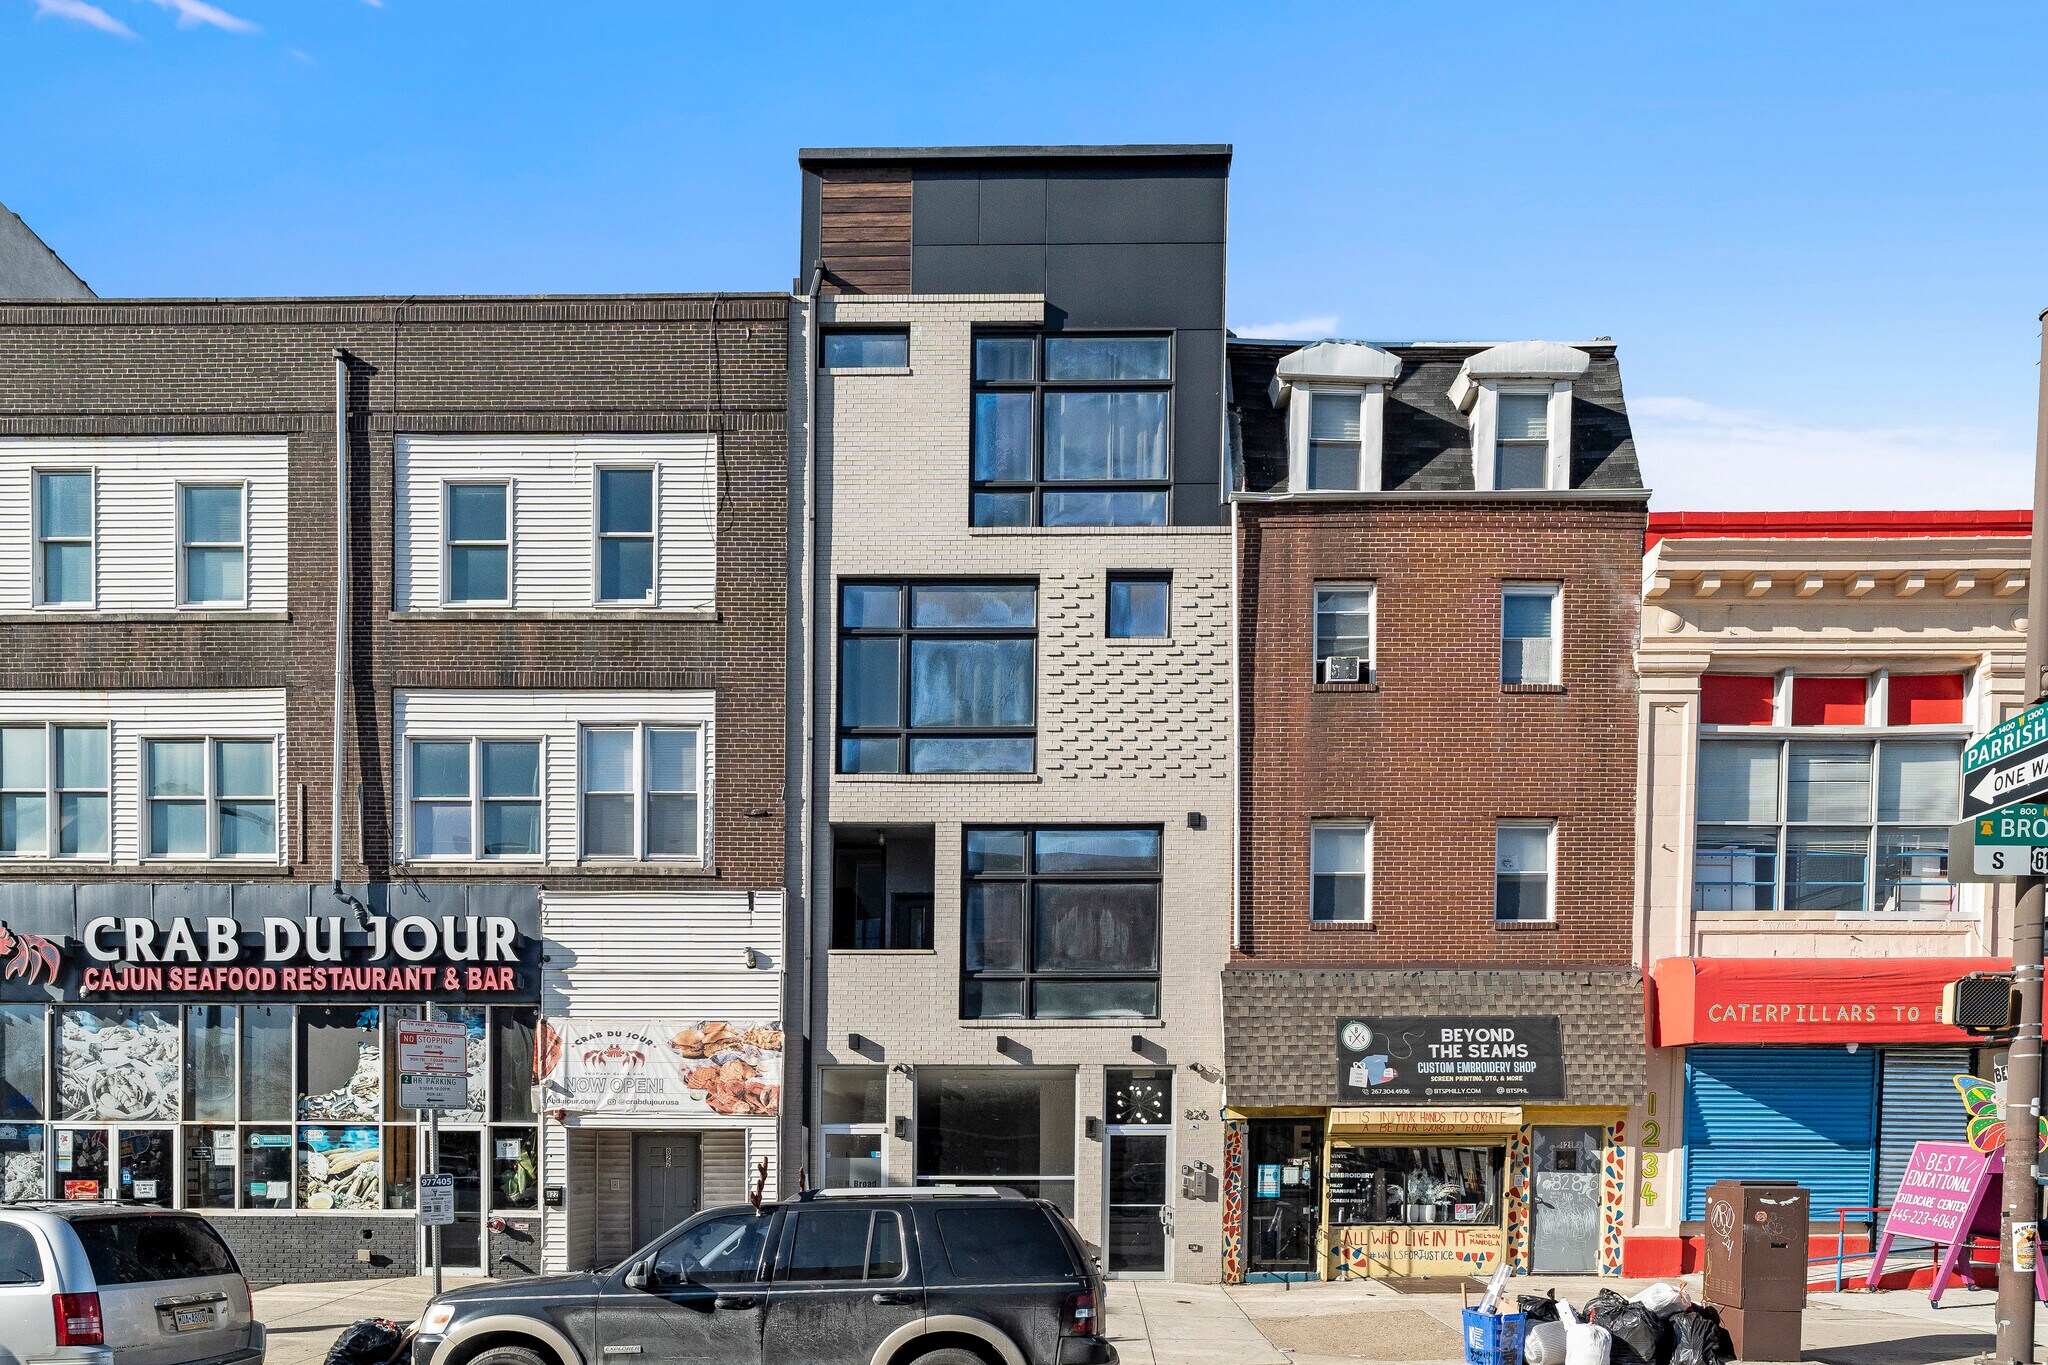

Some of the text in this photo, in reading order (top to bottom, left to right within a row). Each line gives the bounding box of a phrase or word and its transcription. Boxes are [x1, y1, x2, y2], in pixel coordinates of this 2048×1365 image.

[1998, 708, 2045, 735] 1400 W 1300
[1967, 717, 2046, 769] PARRISH
[1994, 767, 2026, 792] ONE
[1992, 851, 2005, 870] S
[84, 915, 521, 962] CRAB DU JOUR
[84, 966, 515, 991] CAJUN SEAFOOD RESTAURANT & BAR
[1708, 1003, 1876, 1023] CATERPILLARS
[1892, 1005, 1920, 1022] TO
[403, 1034, 453, 1045] NO STOPPING
[575, 1031, 603, 1046] CRAB
[626, 1032, 653, 1047] JOUR
[1441, 1028, 1515, 1042] BEYOND
[1428, 1044, 1529, 1058] THE SEAMS
[1417, 1061, 1537, 1074] CUSTOM EMBROIDERY SHOP
[404, 1075, 409, 1083] 2
[426, 1077, 457, 1086] PARKING
[564, 1077, 664, 1094] NOW OPEN!
[1337, 1111, 1507, 1124] IT IS IN YOUR HANDS TO CREATE
[1362, 1123, 1487, 1132] A BETTER WORLD FOR
[1925, 1152, 1968, 1173] BEST
[421, 1178, 452, 1186] 977405
[853, 1180, 877, 1188] Broad
[1905, 1169, 1971, 1193] EDUCATIONAL
[1896, 1192, 1968, 1213] CHILDCARE CENTER
[1892, 1208, 1958, 1230] 445-223-4068
[1343, 1230, 1469, 1247] ALL WHO LIVE IN IT
